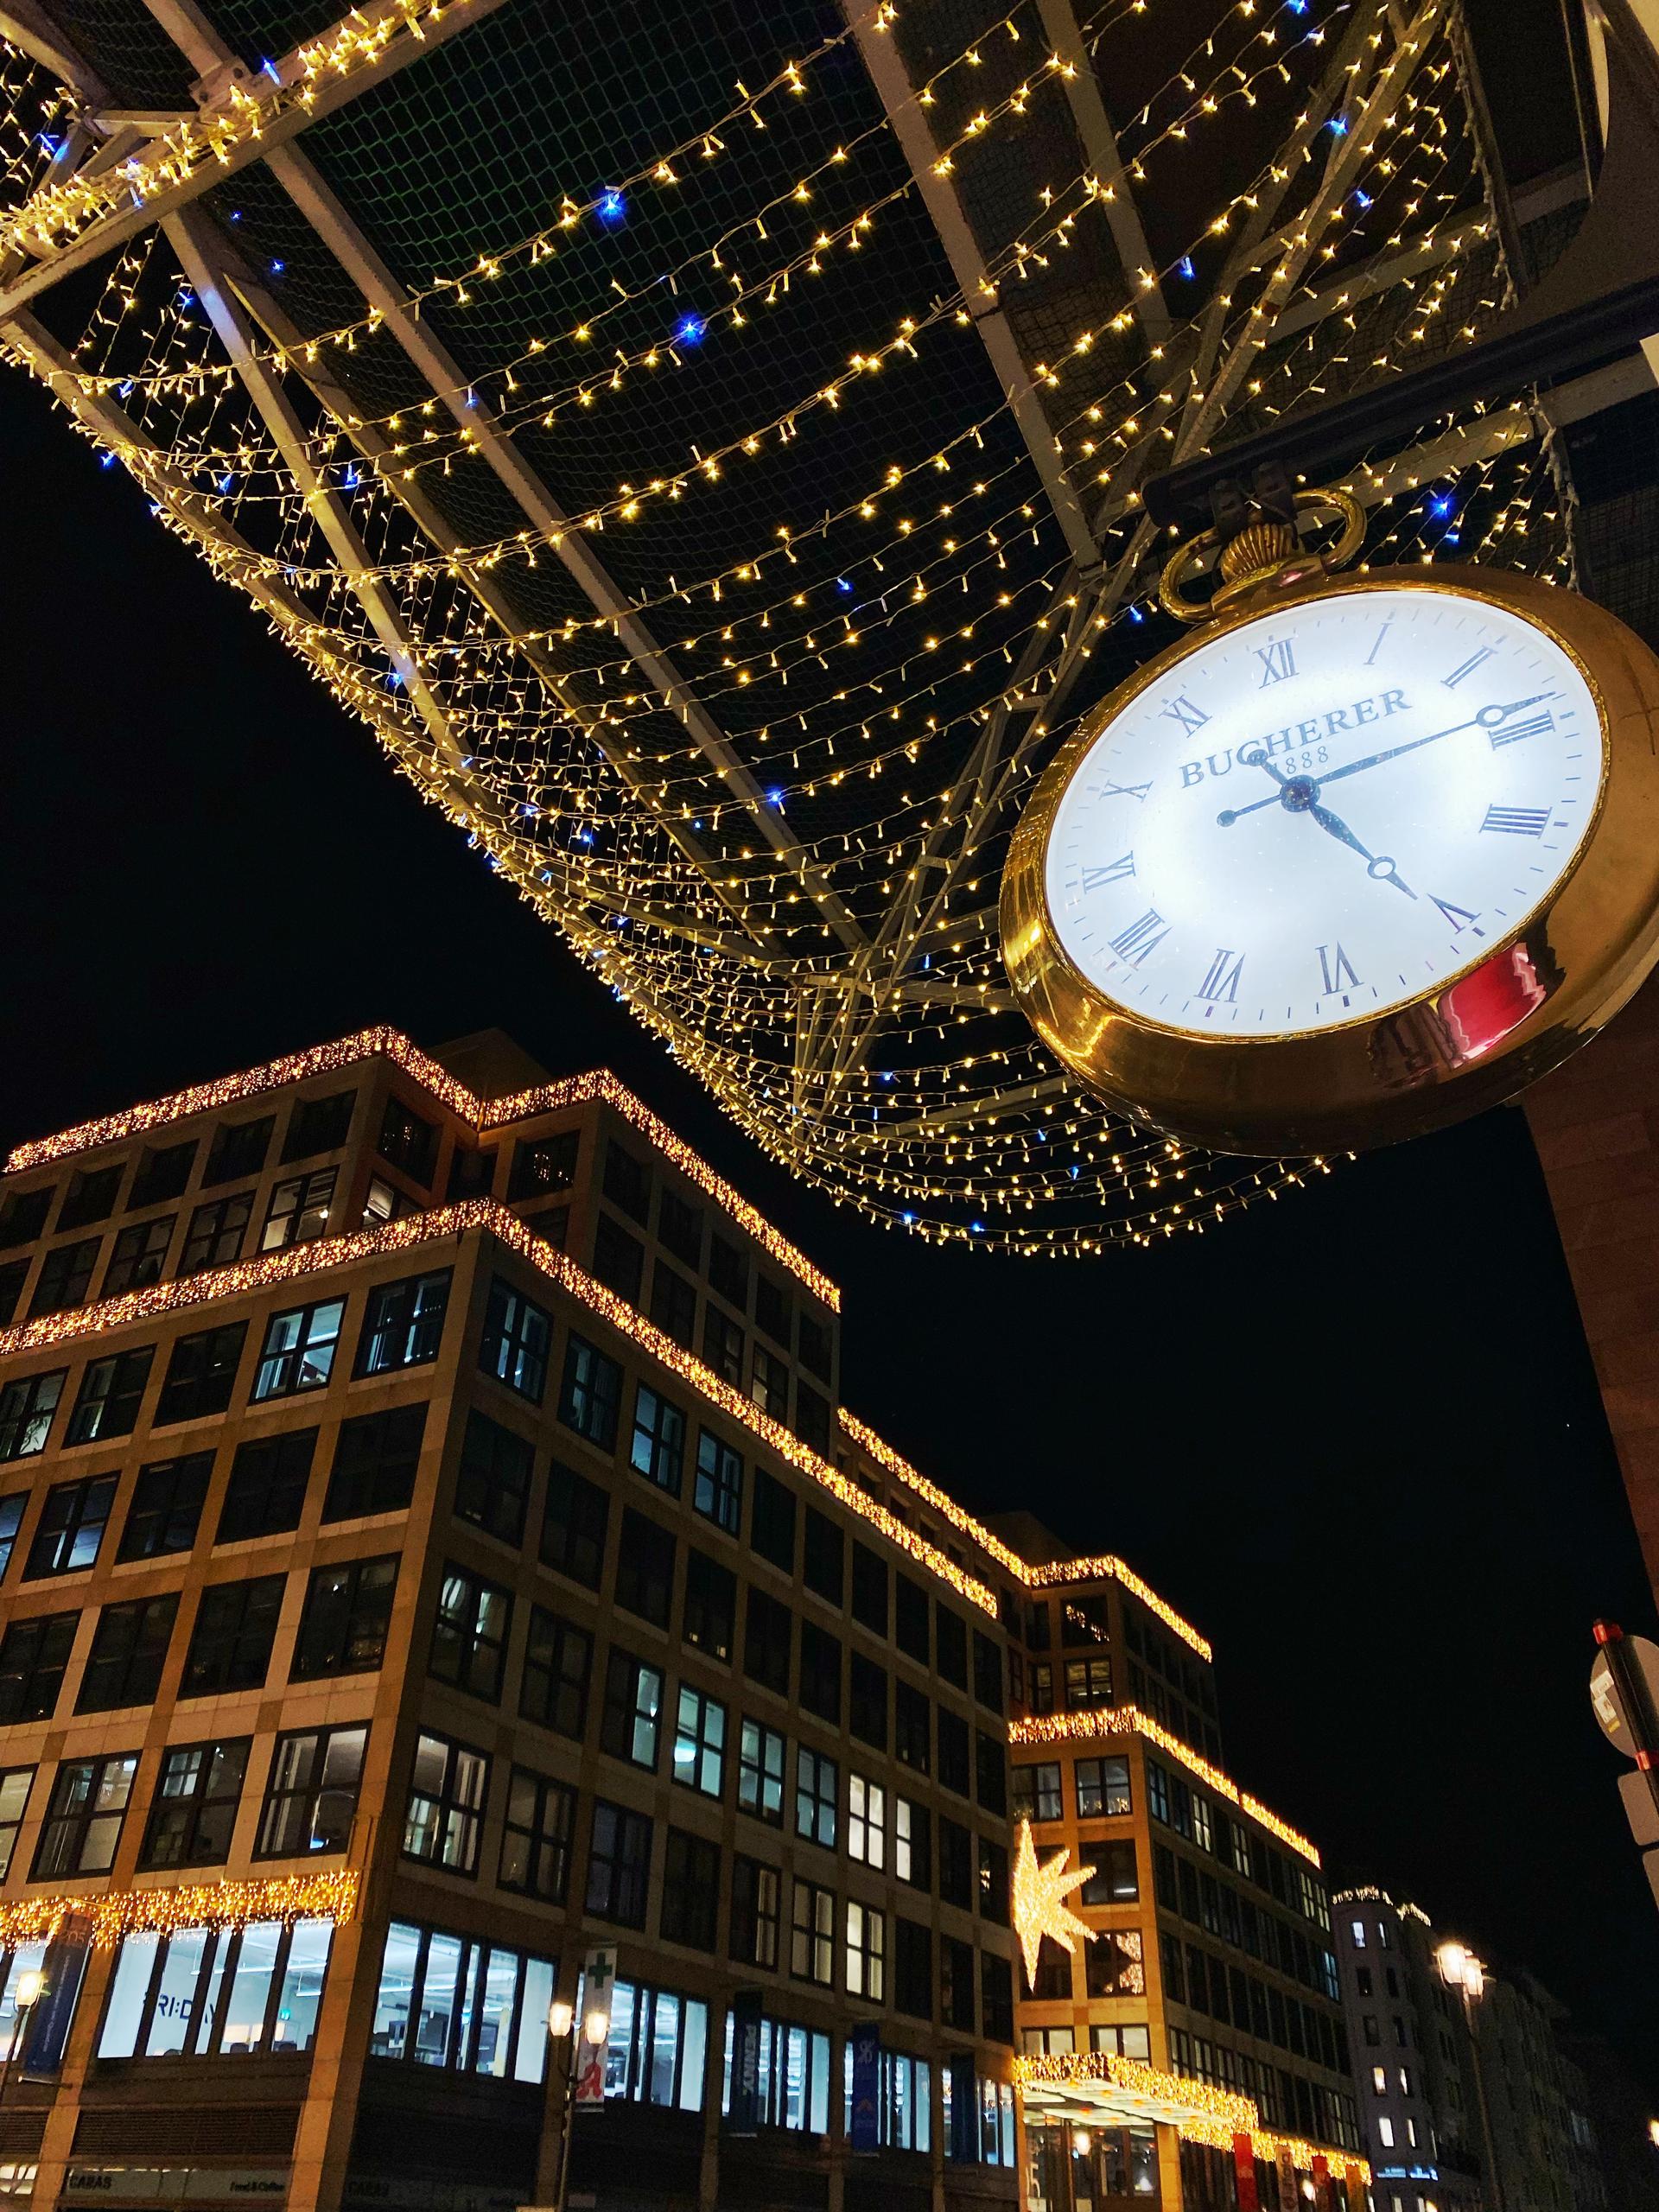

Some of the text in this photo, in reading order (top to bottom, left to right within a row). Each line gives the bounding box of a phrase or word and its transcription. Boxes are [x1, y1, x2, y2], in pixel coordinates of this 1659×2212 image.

[1253, 637, 1300, 690] XII
[1441, 645, 1499, 689] II
[1159, 695, 1212, 738] XI
[1179, 689, 1413, 788] BUCHERER
[1487, 710, 1556, 750] III
[1274, 746, 1329, 775] 888
[1098, 779, 1154, 804] X
[1479, 804, 1553, 839] IIII
[1082, 850, 1136, 894] IX
[1427, 893, 1483, 934] V
[1108, 908, 1173, 971] VIII
[1194, 948, 1247, 1003] VII
[1315, 940, 1364, 996] VI
